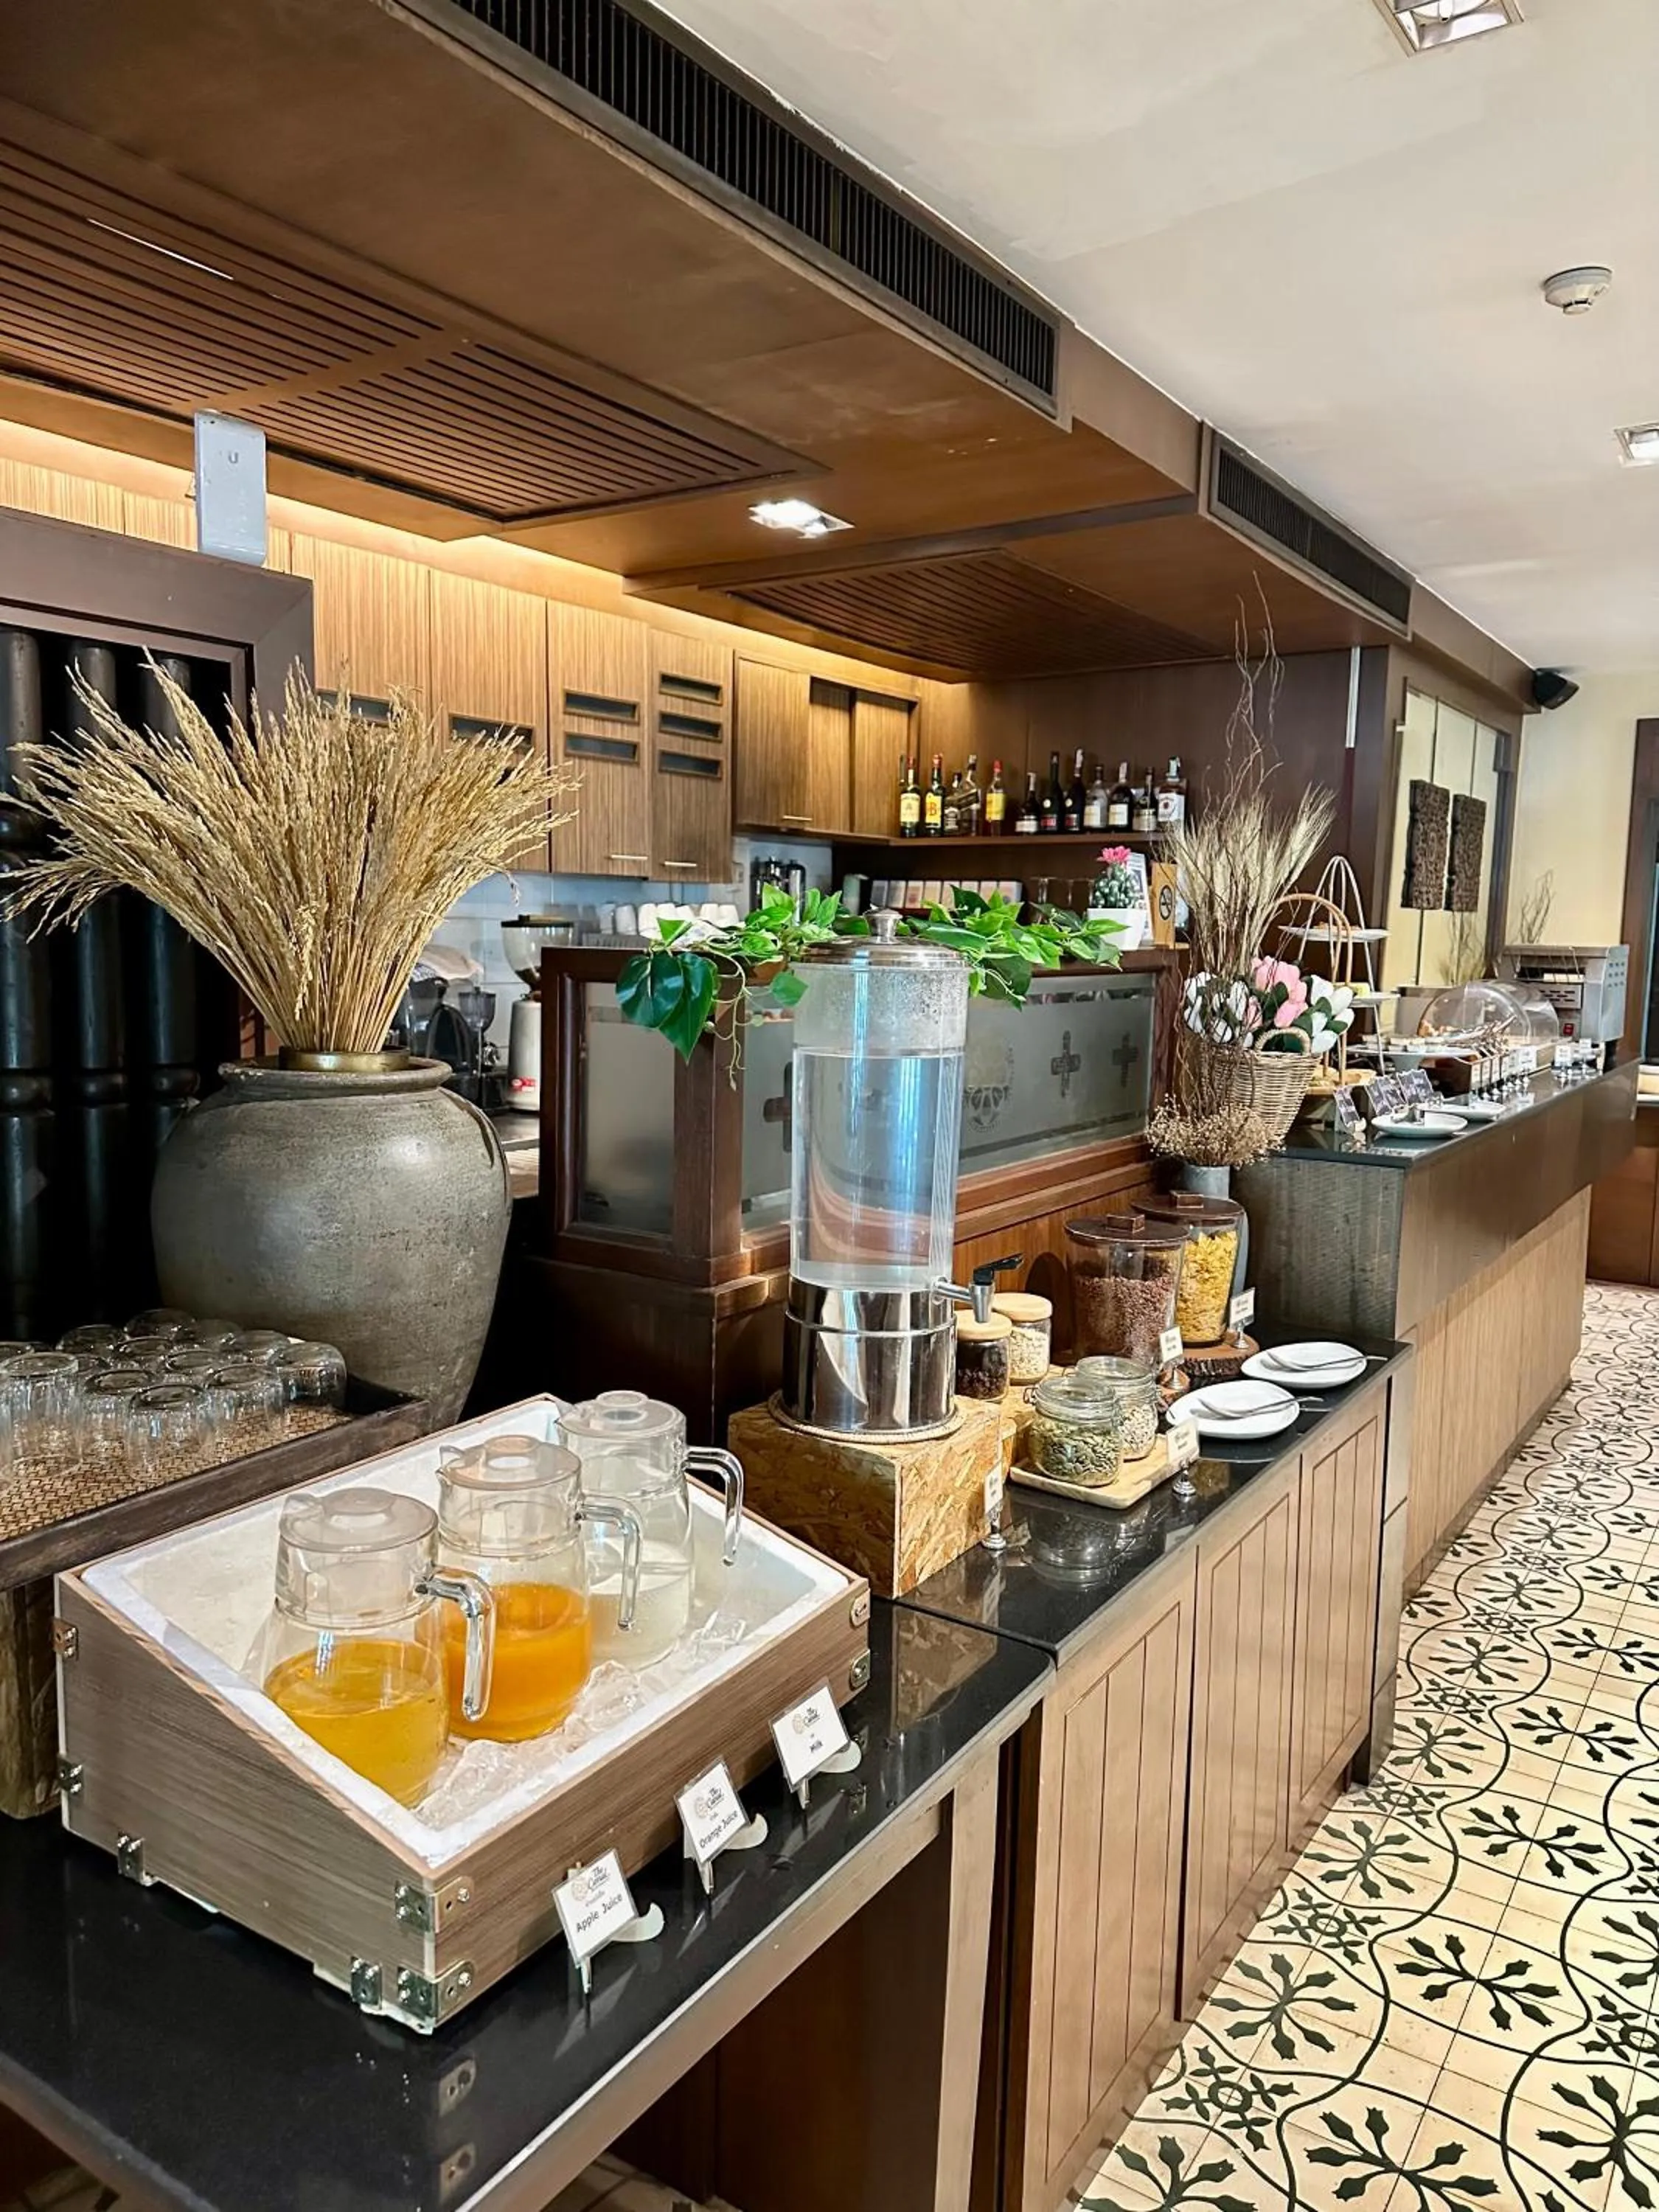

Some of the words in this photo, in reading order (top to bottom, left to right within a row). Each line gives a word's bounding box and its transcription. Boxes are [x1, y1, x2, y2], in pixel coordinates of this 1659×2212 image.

[810, 1739, 823, 1753] Milk
[699, 1825, 722, 1848] Orange
[722, 1810, 738, 1830] Juice
[576, 1910, 599, 1933] Apple
[602, 1893, 622, 1914] Juice
